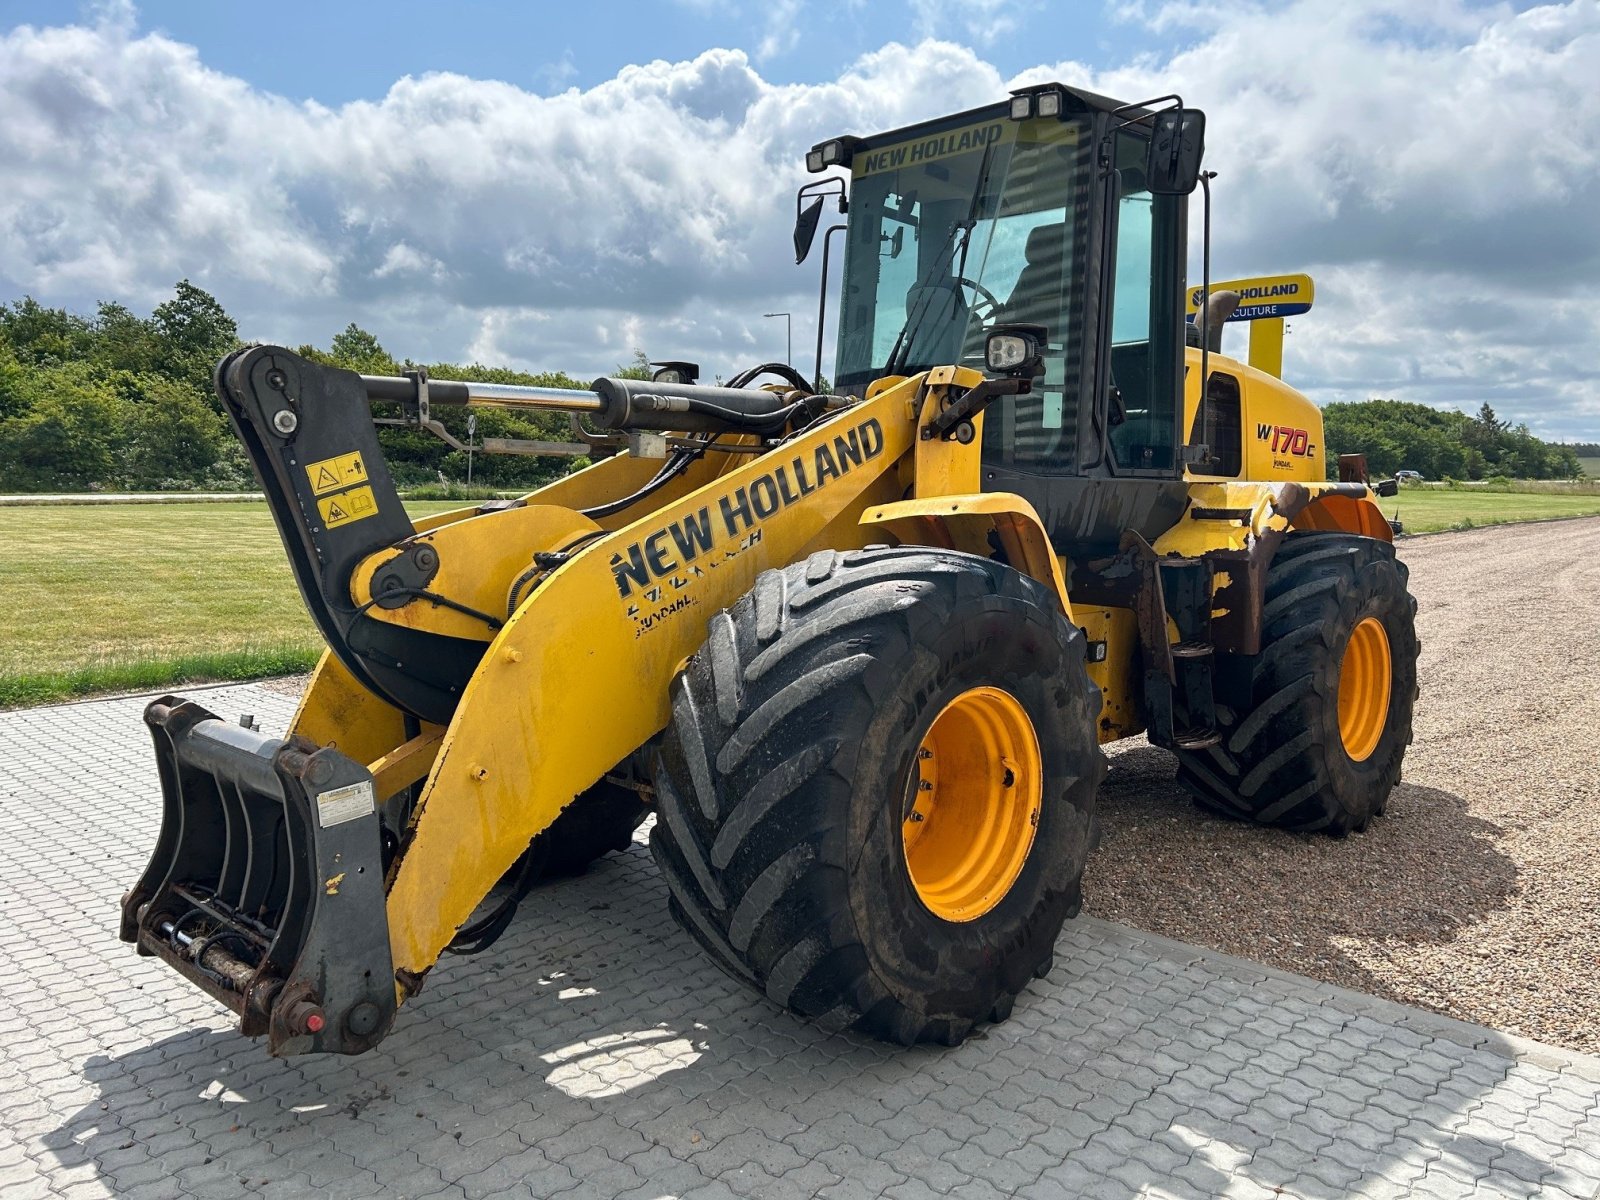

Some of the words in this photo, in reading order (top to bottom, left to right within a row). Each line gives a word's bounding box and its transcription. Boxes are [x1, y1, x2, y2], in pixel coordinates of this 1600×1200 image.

[864, 147, 907, 174] NEW
[910, 124, 1003, 162] HOLLAND
[1240, 283, 1299, 299] HOLLAND
[1229, 305, 1277, 318] CULTURE
[610, 505, 714, 599] NEW
[718, 417, 884, 538] HOLLAND
